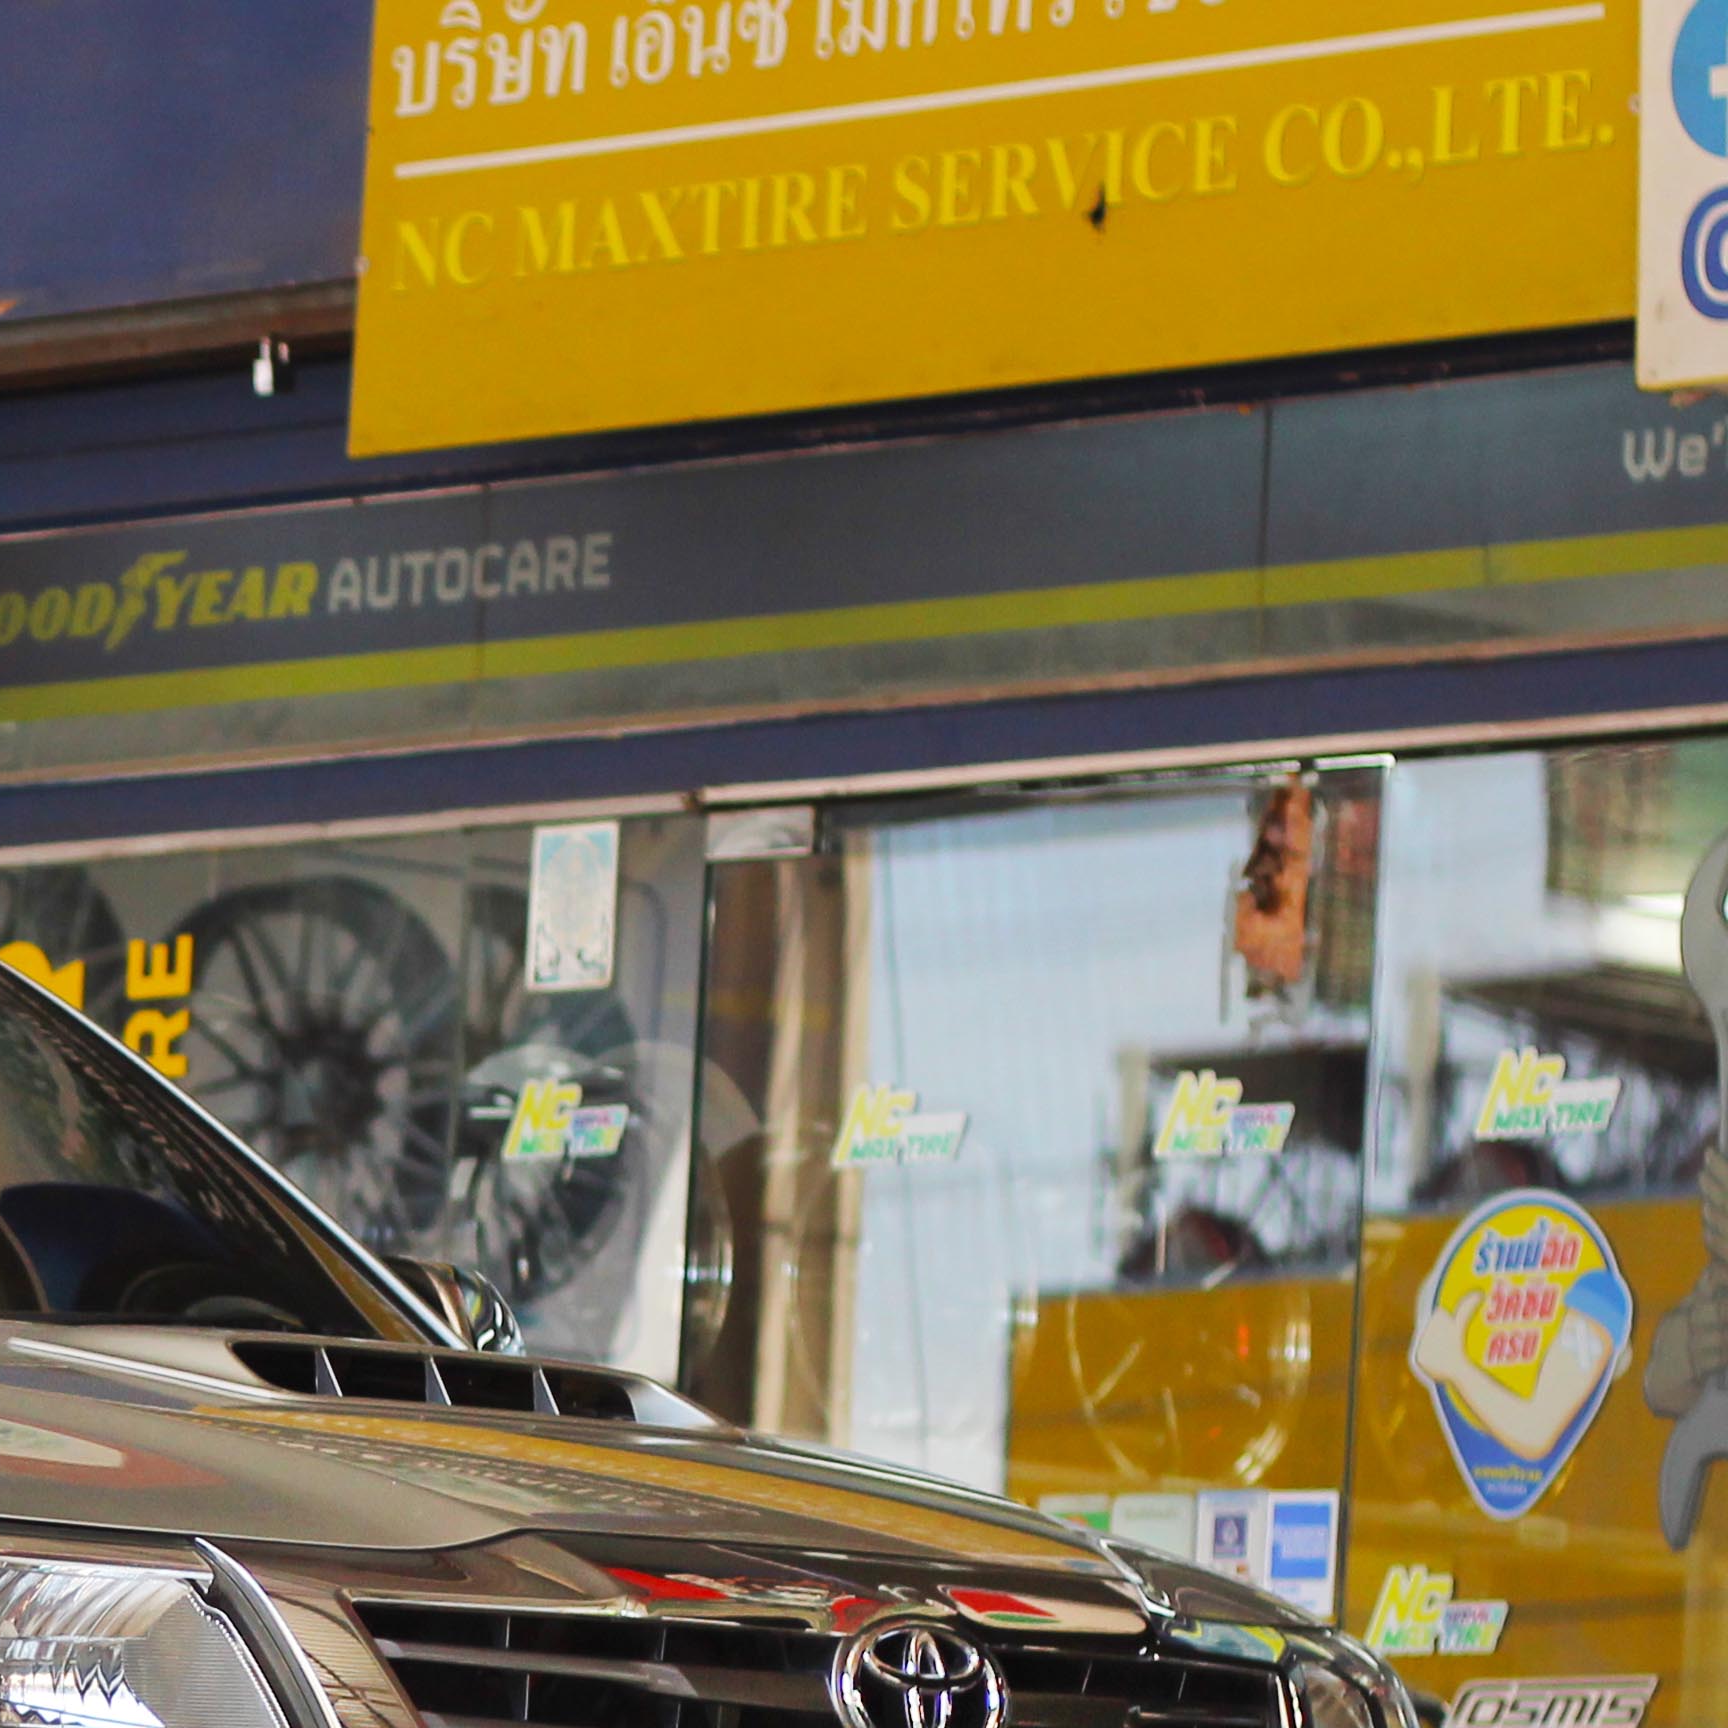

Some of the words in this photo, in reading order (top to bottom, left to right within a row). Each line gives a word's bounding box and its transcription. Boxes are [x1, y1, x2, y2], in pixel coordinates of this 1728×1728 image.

[390, 210, 494, 291] NC
[513, 163, 869, 279] MAXTIRE
[889, 114, 1238, 233] SERVICE
[327, 532, 614, 614] AUTOCARE
[507, 1078, 578, 1156] NC
[837, 1086, 915, 1162] NC
[1159, 1076, 1241, 1152] NC
[1479, 1054, 1561, 1132] NC
[1368, 1572, 1450, 1648] NC
